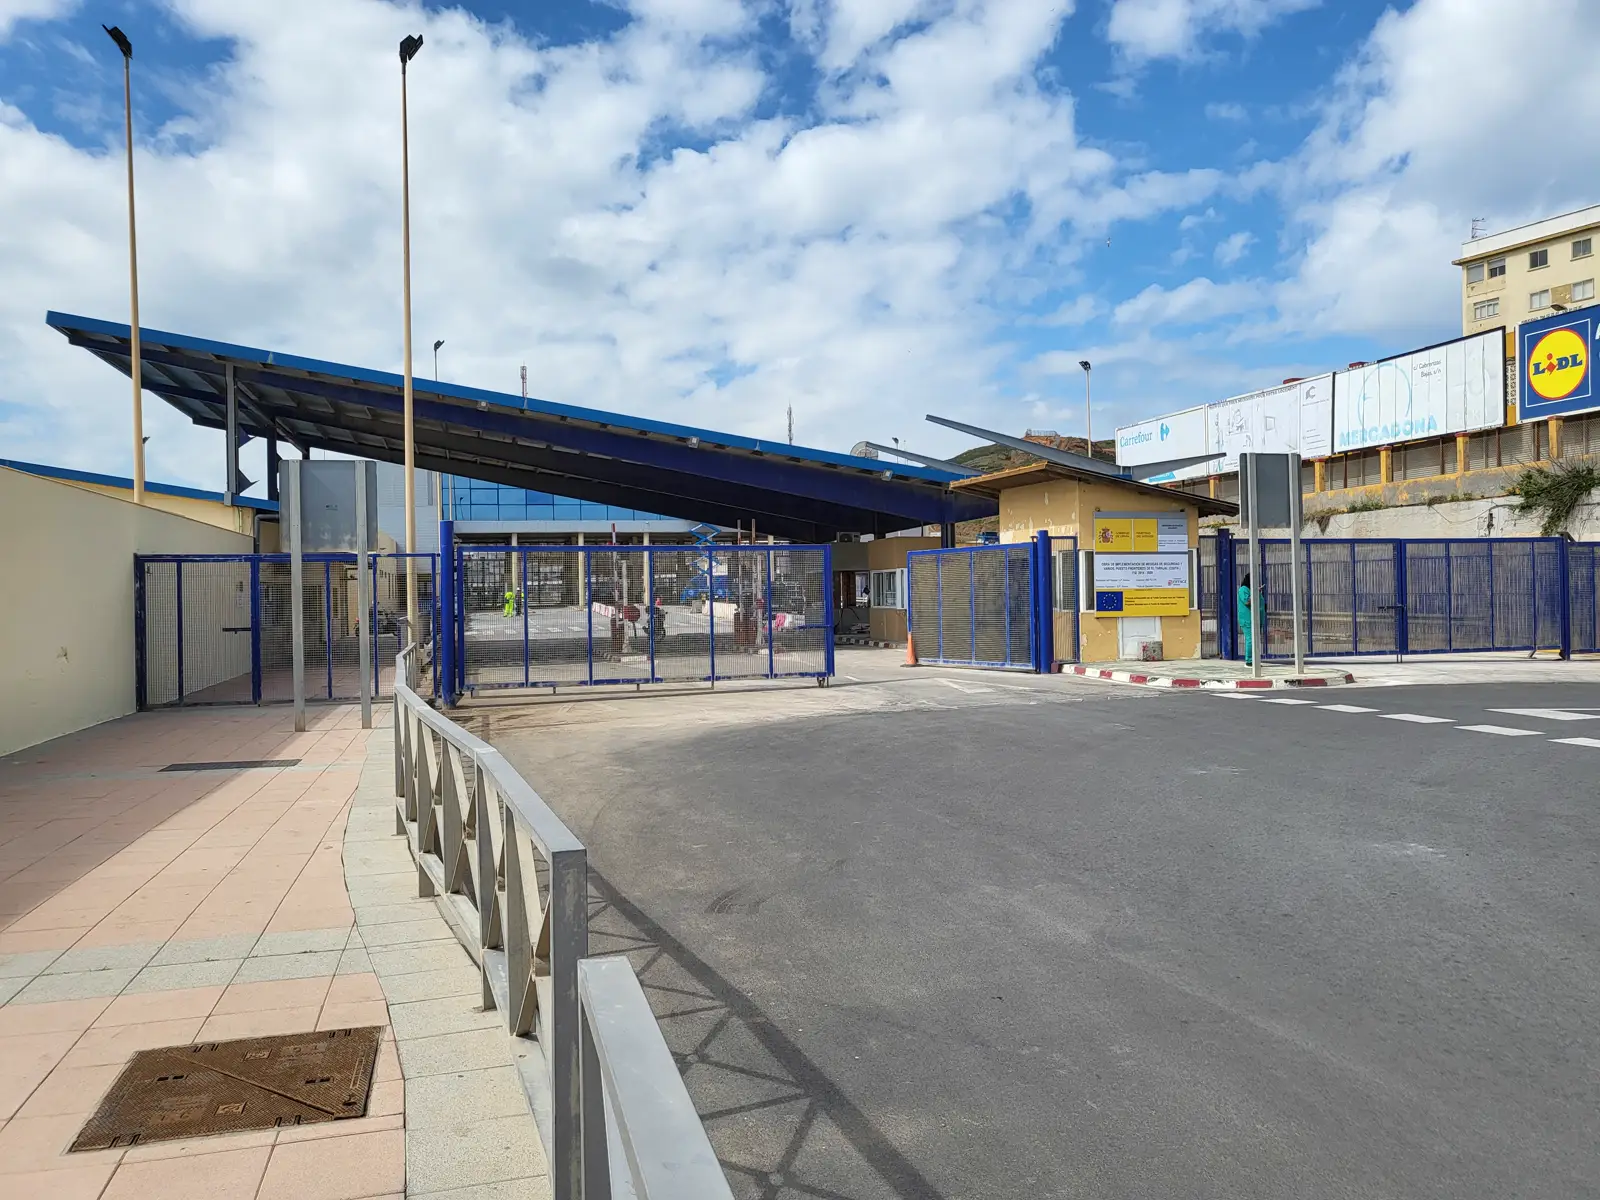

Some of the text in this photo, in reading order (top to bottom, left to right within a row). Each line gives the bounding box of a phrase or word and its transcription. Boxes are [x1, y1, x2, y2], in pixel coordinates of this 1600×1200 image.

[1532, 353, 1583, 375] LIDL
[1120, 431, 1153, 448] Carrefour
[1339, 415, 1438, 447] MERCADONA
